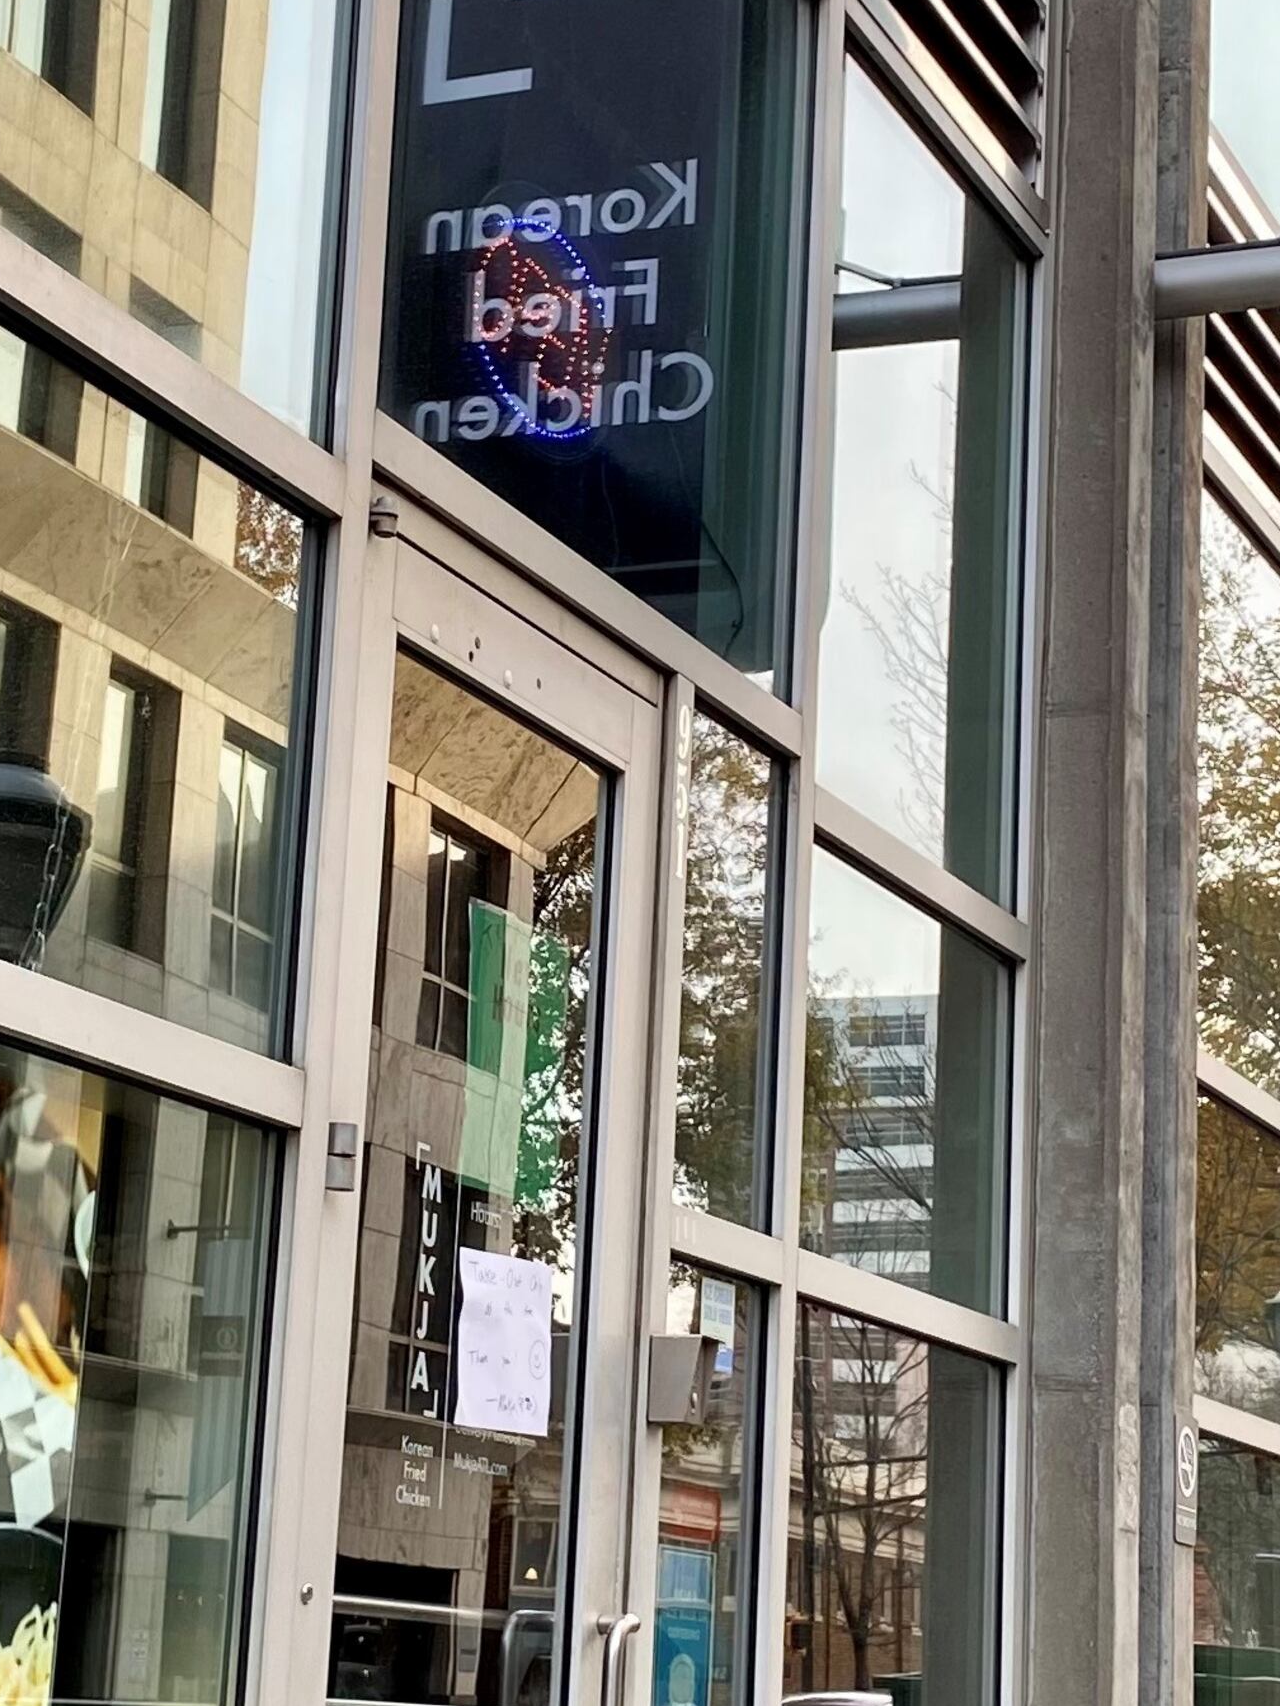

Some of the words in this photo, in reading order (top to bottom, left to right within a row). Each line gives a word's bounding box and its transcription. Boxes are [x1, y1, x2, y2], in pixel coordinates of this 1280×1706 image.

[675, 705, 691, 879] 951
[411, 1164, 442, 1393] MUKJA
[400, 1435, 434, 1459] Korean
[403, 1460, 427, 1483] Fried
[395, 1484, 431, 1508] Chicken
